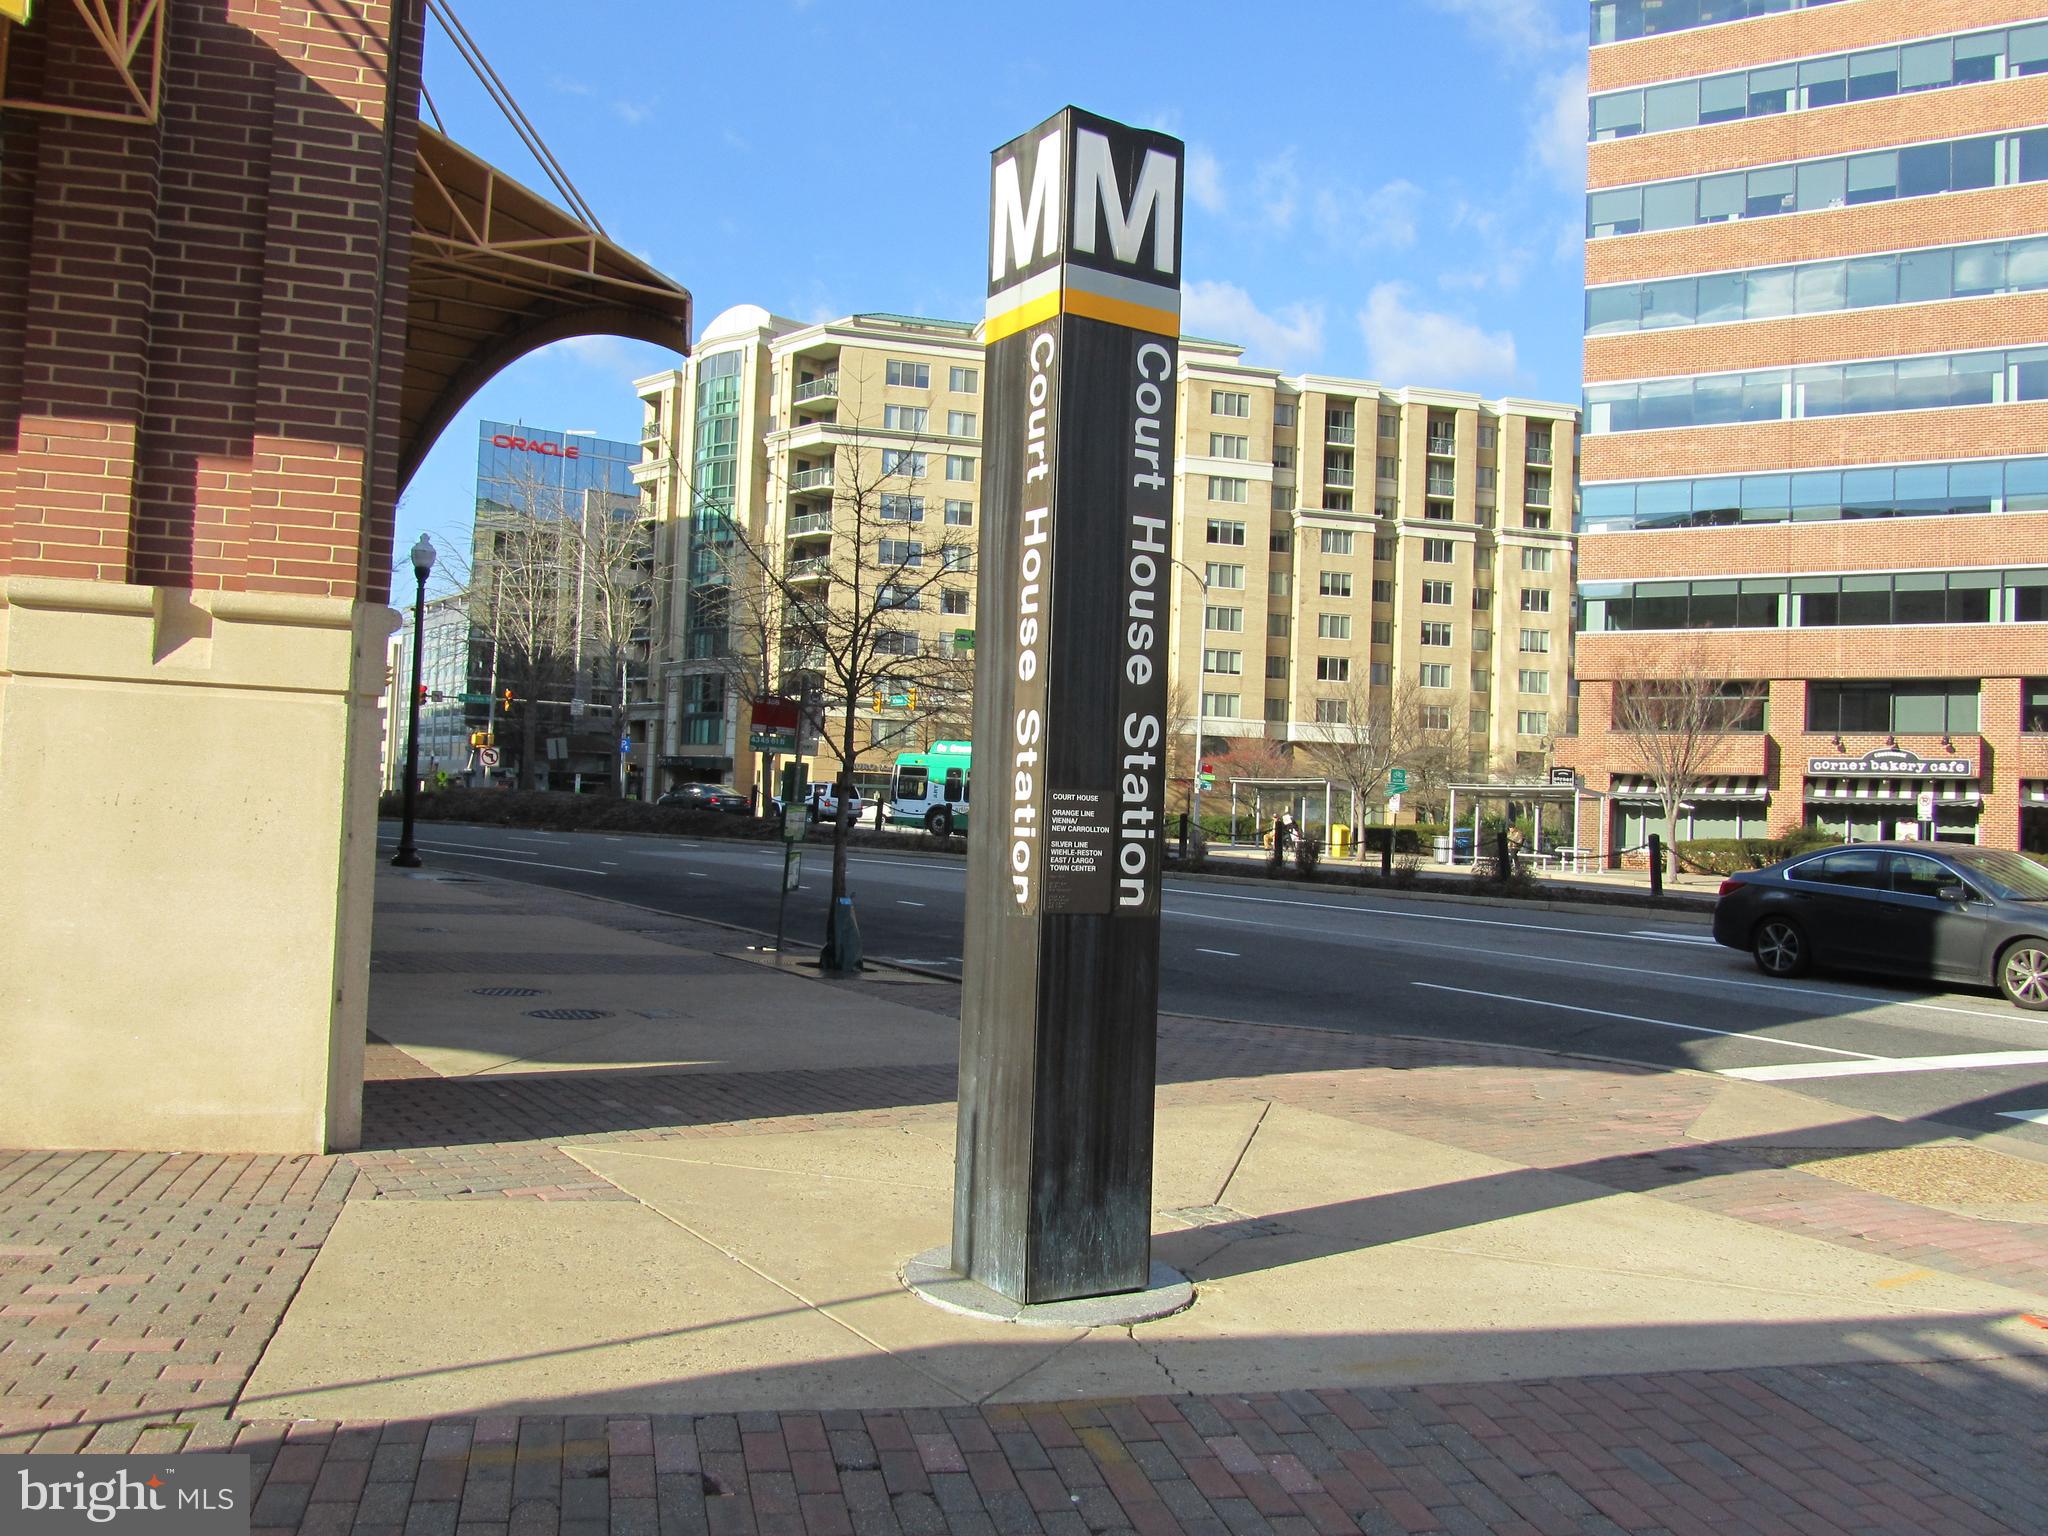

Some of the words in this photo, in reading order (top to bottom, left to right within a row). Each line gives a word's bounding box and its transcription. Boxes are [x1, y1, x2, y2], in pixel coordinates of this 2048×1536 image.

[991, 129, 1061, 282] M
[1073, 126, 1177, 274] M
[491, 434, 580, 459] ORACLE
[1026, 332, 1054, 484] Court
[1133, 342, 1171, 490] Court
[1018, 507, 1048, 681] House
[1126, 515, 1166, 686] House
[1012, 709, 1040, 904] Station
[1051, 817, 1078, 825] VIENNA/
[1052, 793, 1075, 801] COURT
[1076, 794, 1099, 802] HOUSE
[1052, 809, 1079, 817] ORANGE
[1119, 712, 1159, 907] Station
[1813, 760, 1867, 771] corner
[1870, 759, 1927, 774] bakery
[1930, 760, 1965, 772] cafe
